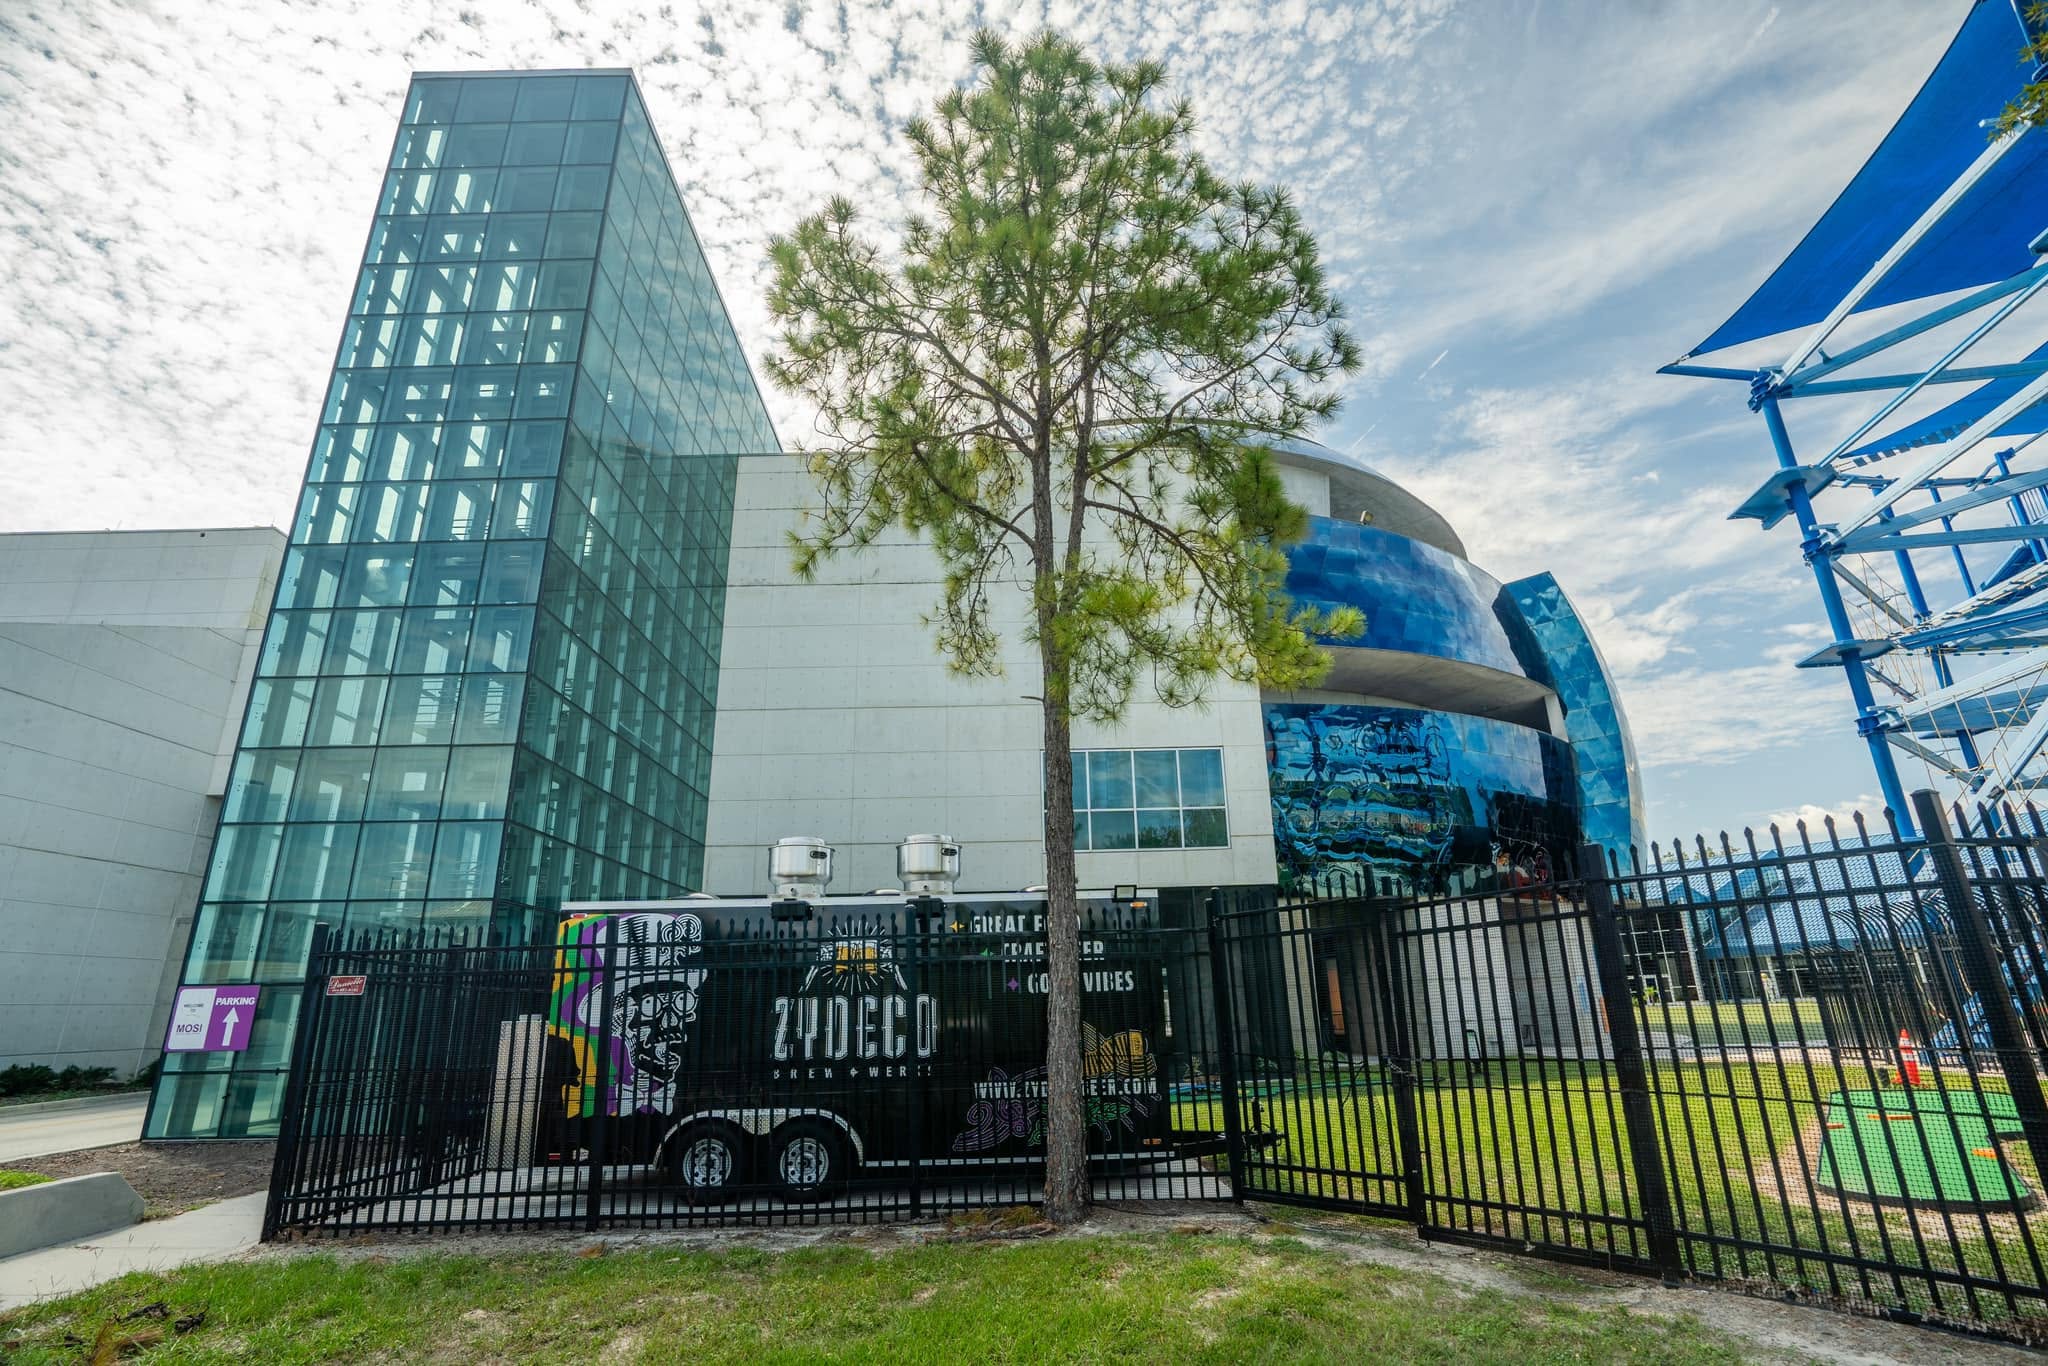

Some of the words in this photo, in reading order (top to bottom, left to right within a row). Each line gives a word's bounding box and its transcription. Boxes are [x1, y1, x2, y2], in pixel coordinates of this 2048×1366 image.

[970, 914, 1026, 933] GREAT
[1001, 942, 1048, 962] CRAF
[1082, 970, 1135, 992] VIBES
[215, 996, 256, 1006] PARKING
[176, 1023, 203, 1033] MOSI
[770, 993, 938, 1061] ZYDECO
[773, 1067, 833, 1080] BREW
[868, 1064, 932, 1078] WER
